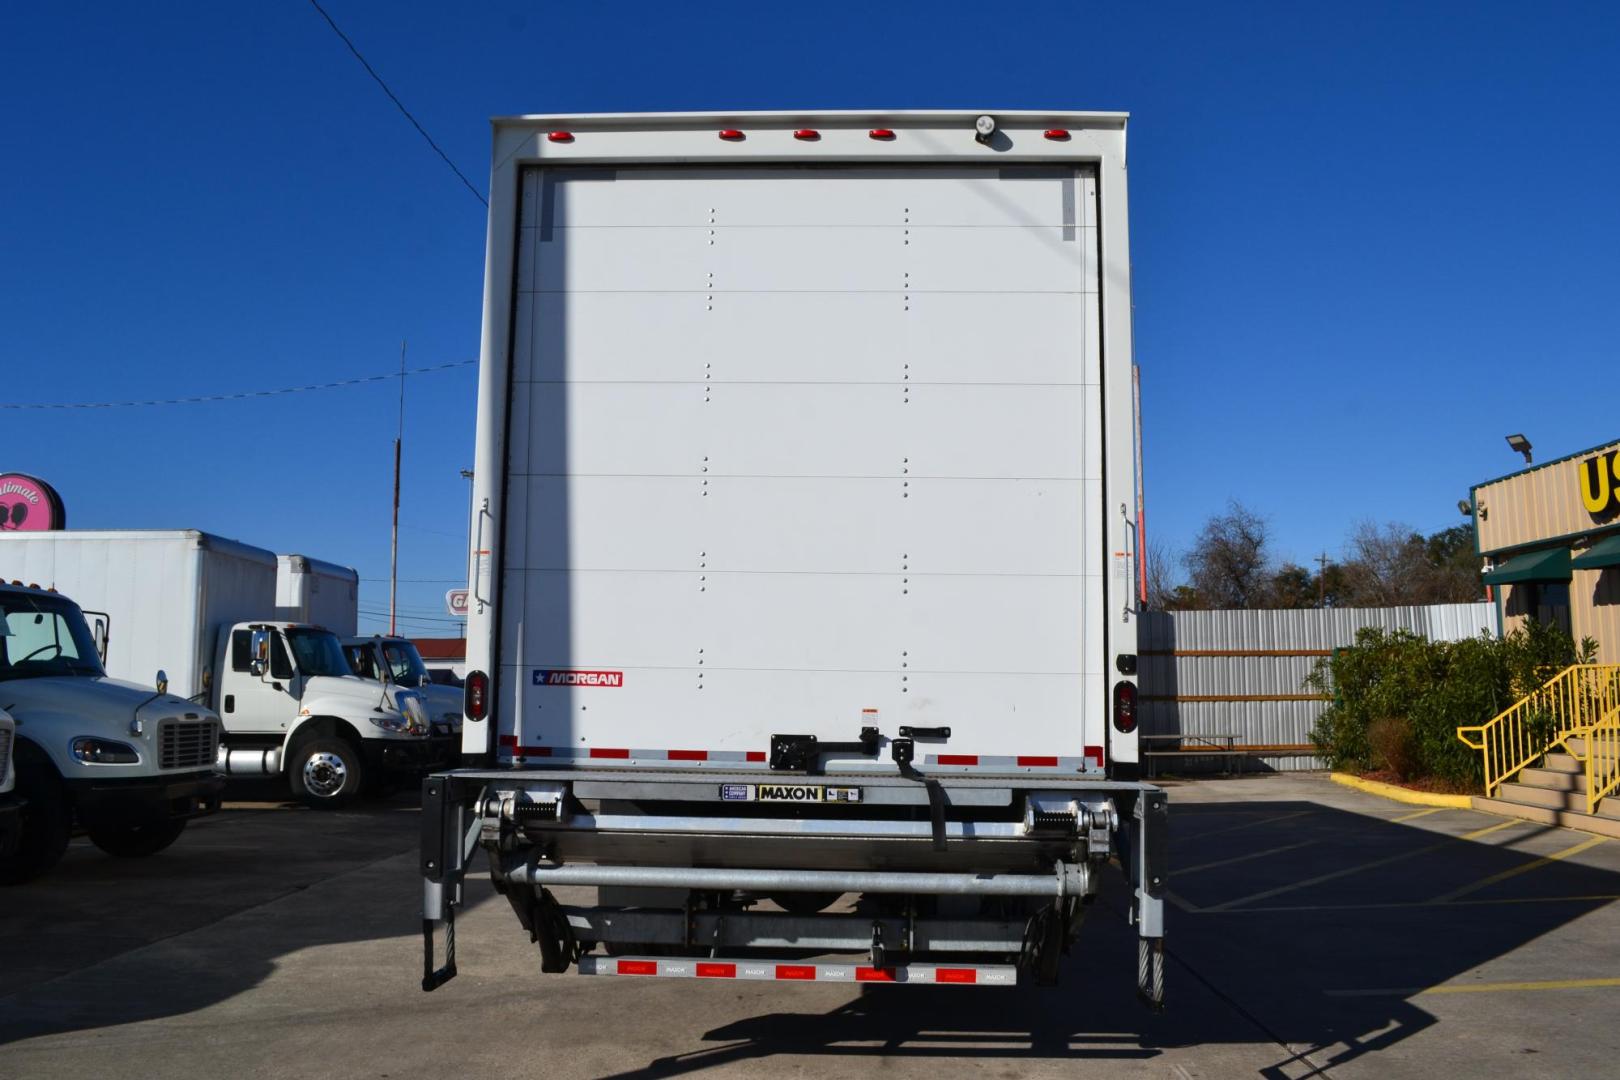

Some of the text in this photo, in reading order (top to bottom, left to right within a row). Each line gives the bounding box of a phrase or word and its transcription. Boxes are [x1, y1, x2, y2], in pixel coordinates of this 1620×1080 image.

[1579, 451, 1620, 513] U
[0, 481, 39, 505] timate
[549, 672, 619, 685] MORGAN
[760, 786, 819, 800] MAXON
